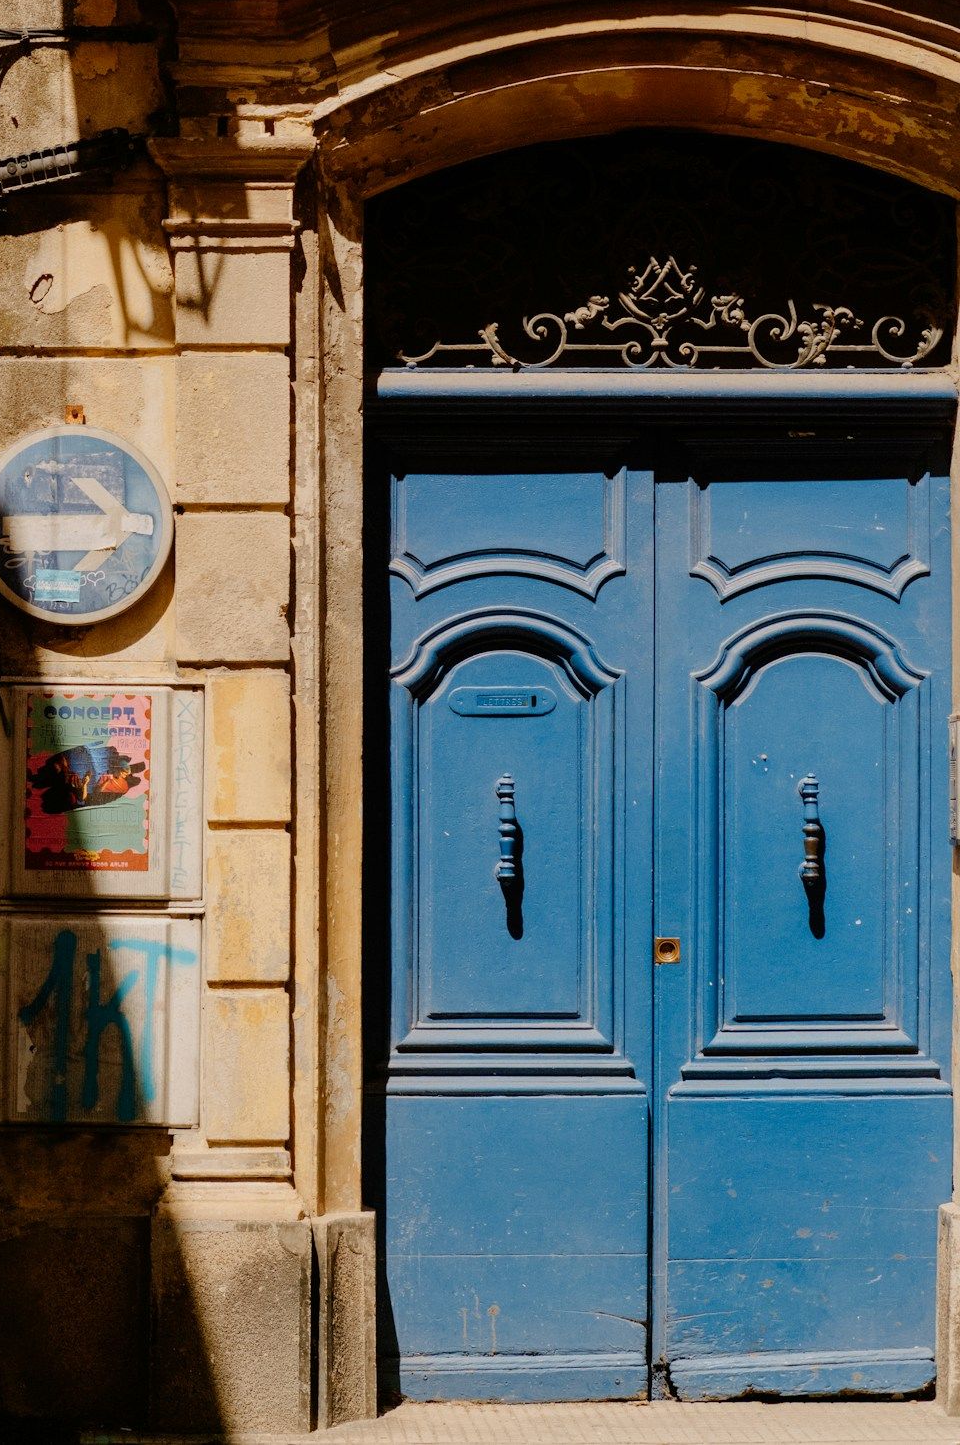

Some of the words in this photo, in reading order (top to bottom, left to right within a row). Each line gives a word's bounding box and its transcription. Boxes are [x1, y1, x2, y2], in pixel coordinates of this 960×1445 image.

[482, 698, 523, 706] LETTRES
[43, 705, 135, 721] CONCERT
[109, 861, 129, 869] ARLES
